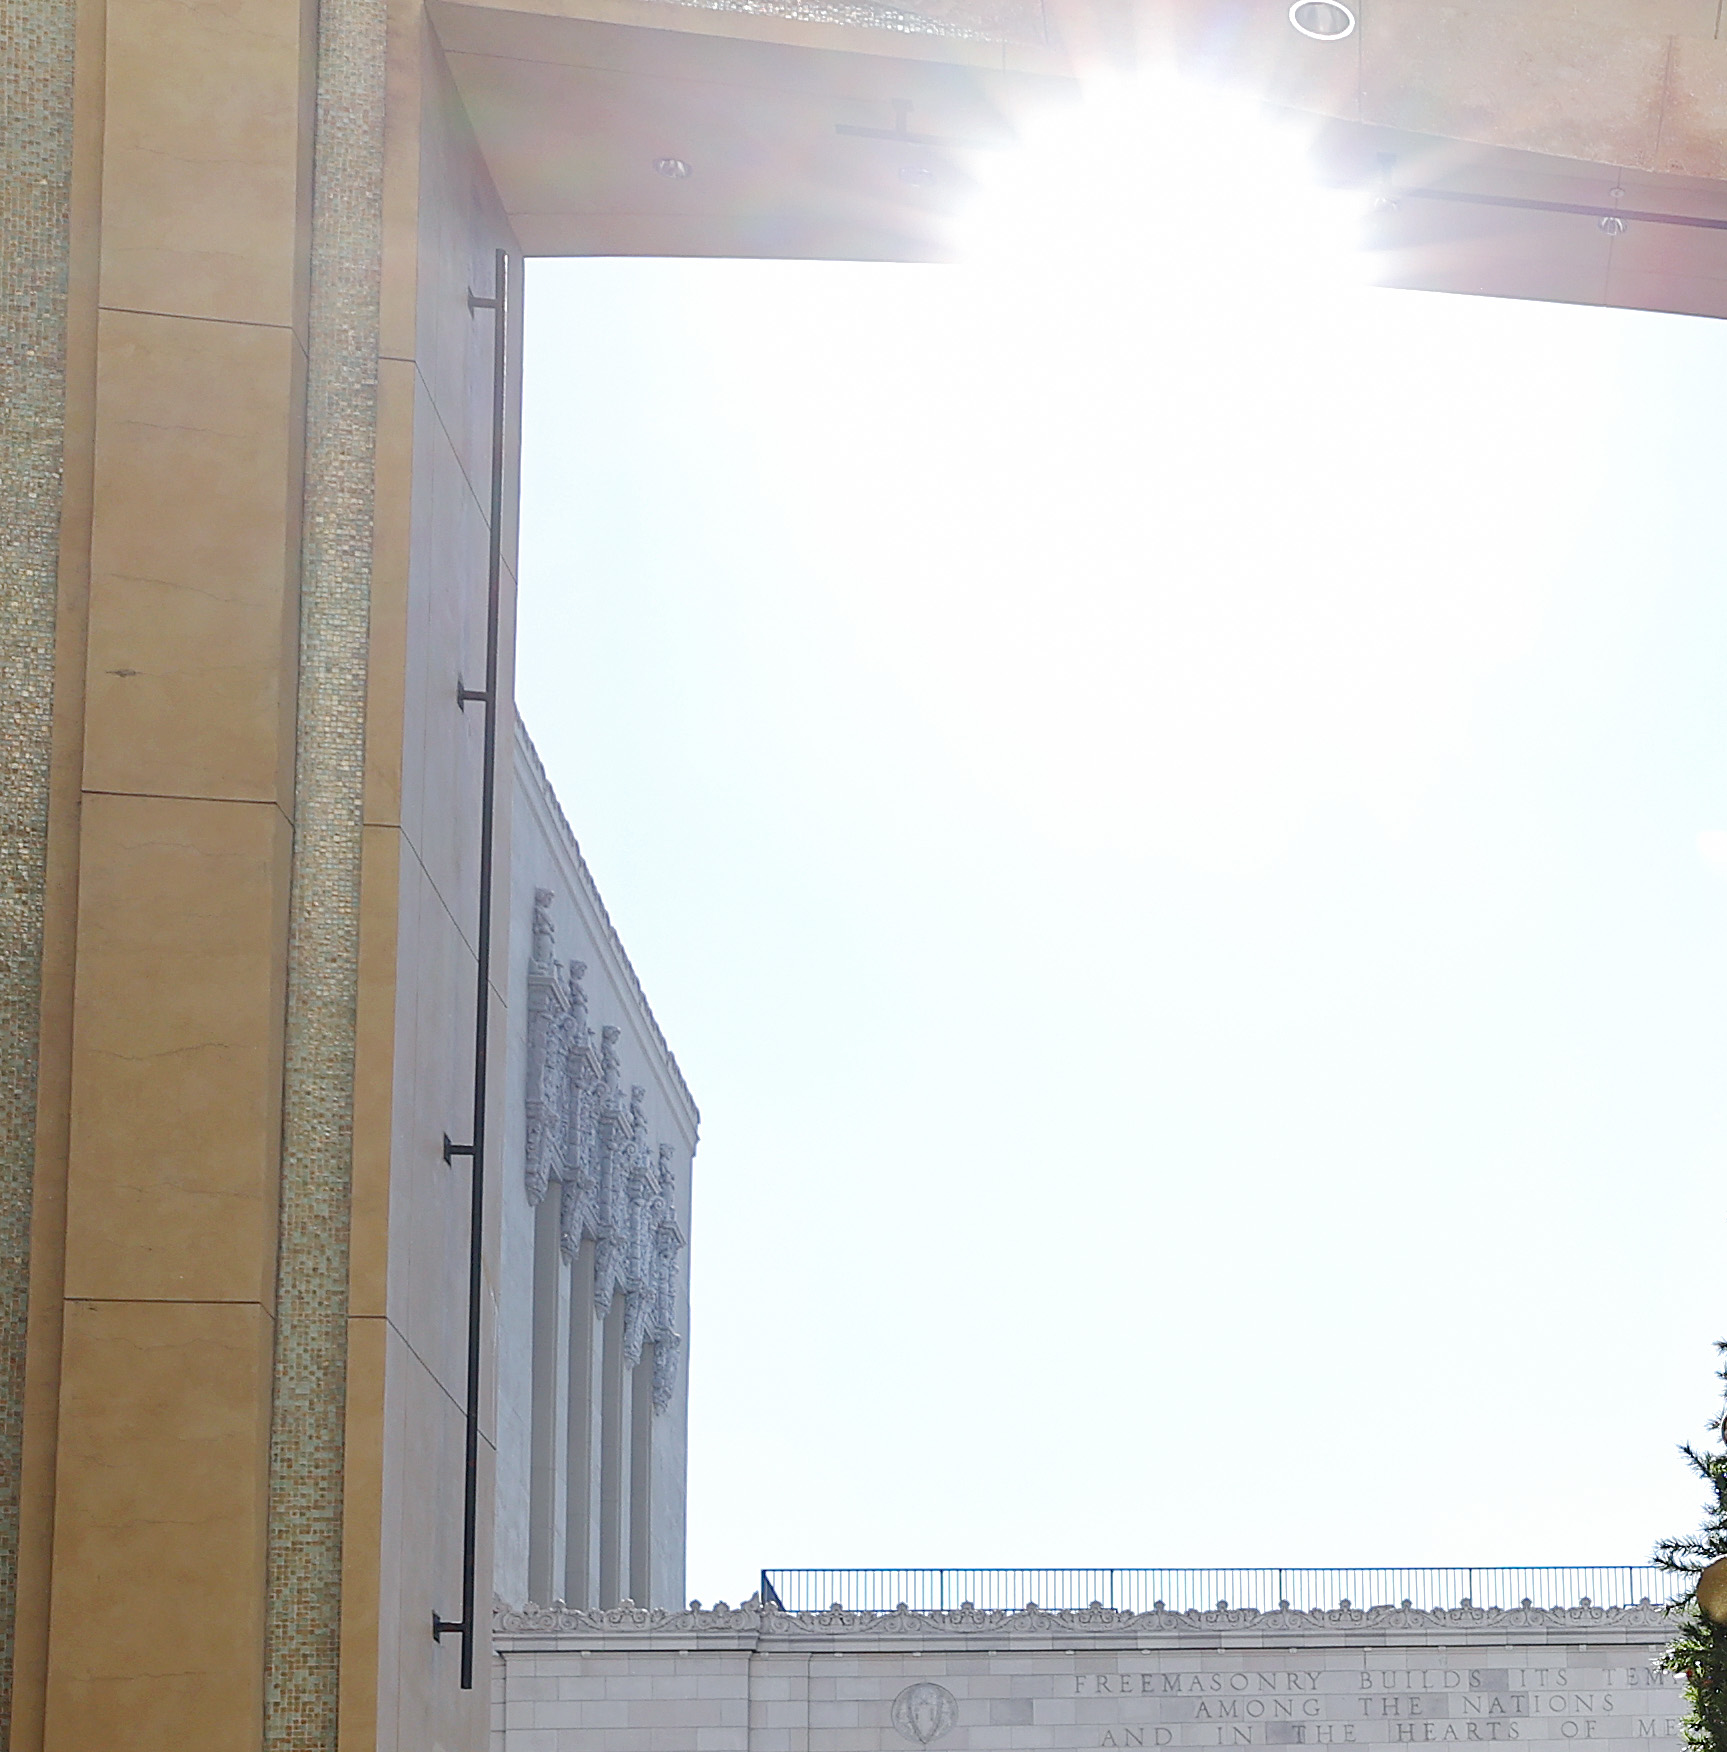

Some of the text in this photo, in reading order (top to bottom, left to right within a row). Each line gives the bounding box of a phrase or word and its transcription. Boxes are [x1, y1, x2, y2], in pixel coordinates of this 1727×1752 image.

[1074, 1671, 1322, 1693] FREEMASONRY
[1360, 1668, 1481, 1690] BUILDS
[1520, 1667, 1569, 1688] ITS
[1195, 1694, 1615, 1718] AMONG THE NATIONS
[1101, 1718, 1678, 1747] AND IN THE HEARTS OF ME
